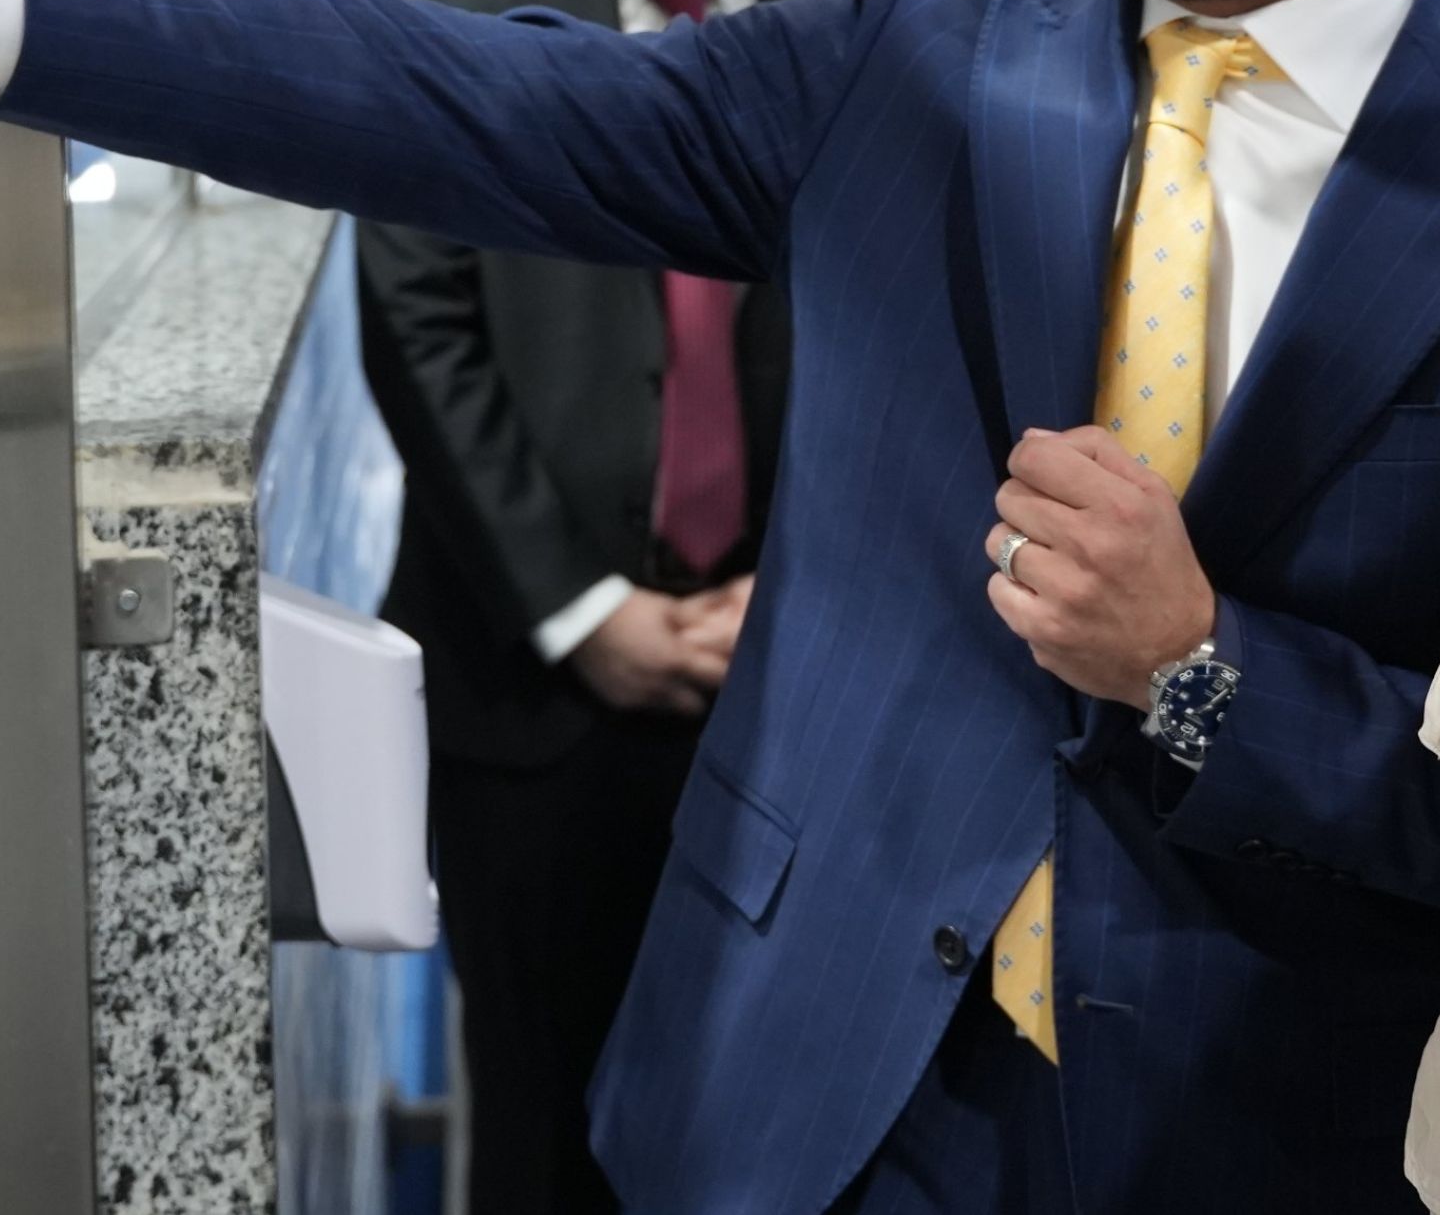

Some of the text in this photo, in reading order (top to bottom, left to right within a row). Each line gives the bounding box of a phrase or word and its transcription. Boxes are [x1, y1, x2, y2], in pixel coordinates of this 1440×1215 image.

[1178, 669, 1194, 681] 20
[1221, 669, 1236, 681] 30
[1180, 721, 1198, 736] 12
